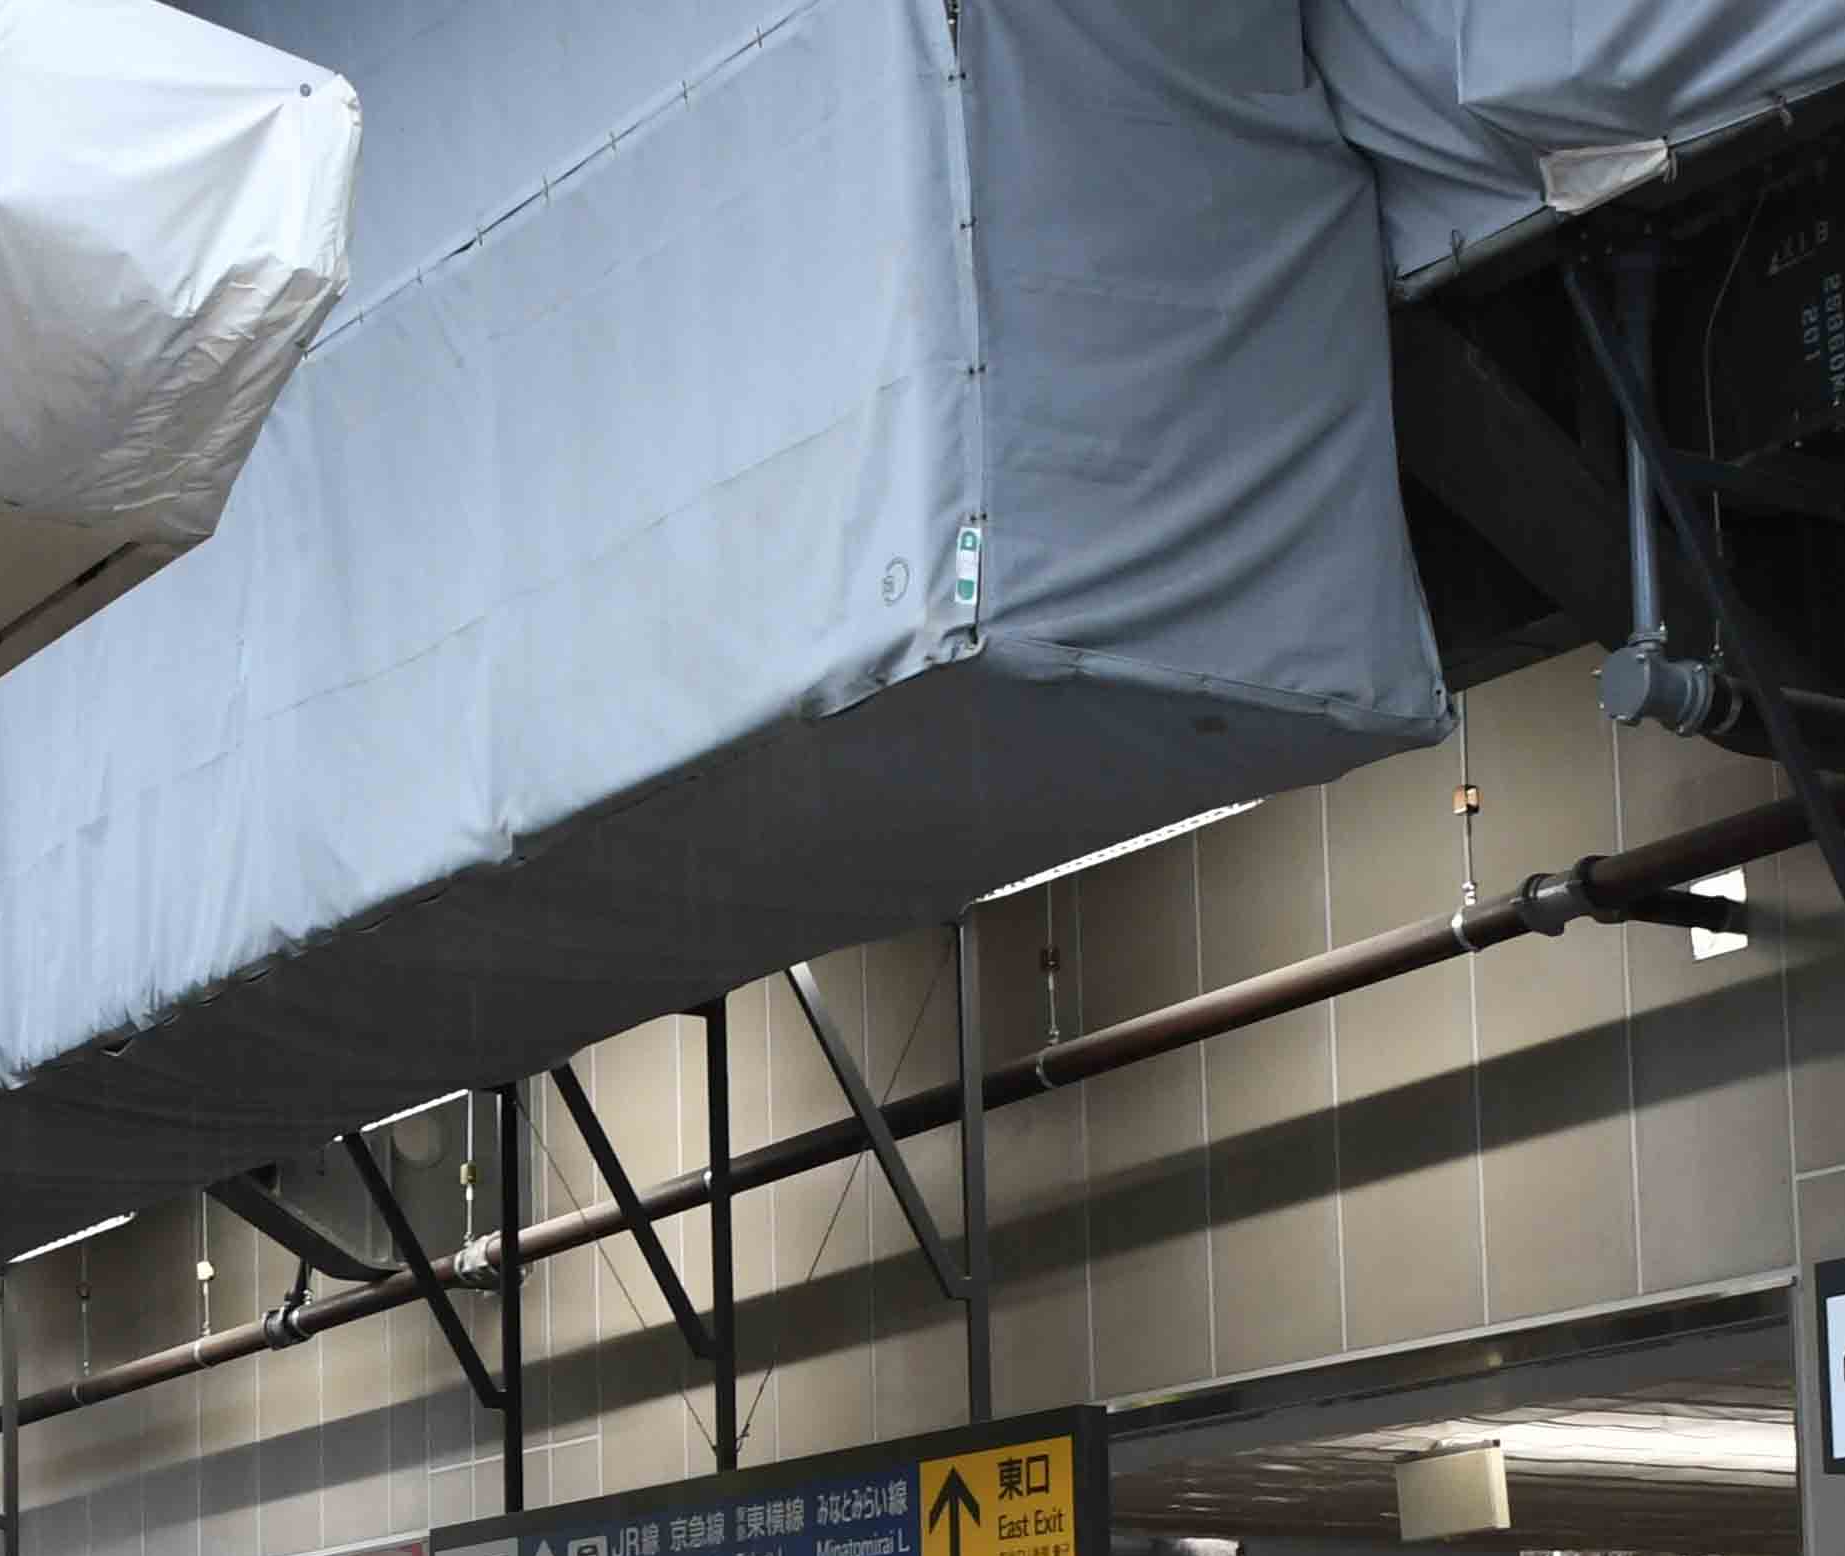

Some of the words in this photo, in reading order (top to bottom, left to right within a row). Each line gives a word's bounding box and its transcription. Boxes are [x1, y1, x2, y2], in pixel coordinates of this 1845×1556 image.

[669, 1512, 725, 1551] 京急線
[816, 1480, 908, 1524] みなとみらい線
[997, 1454, 1050, 1501] 東口
[998, 1514, 1029, 1540] East
[1034, 1508, 1064, 1535] Exit
